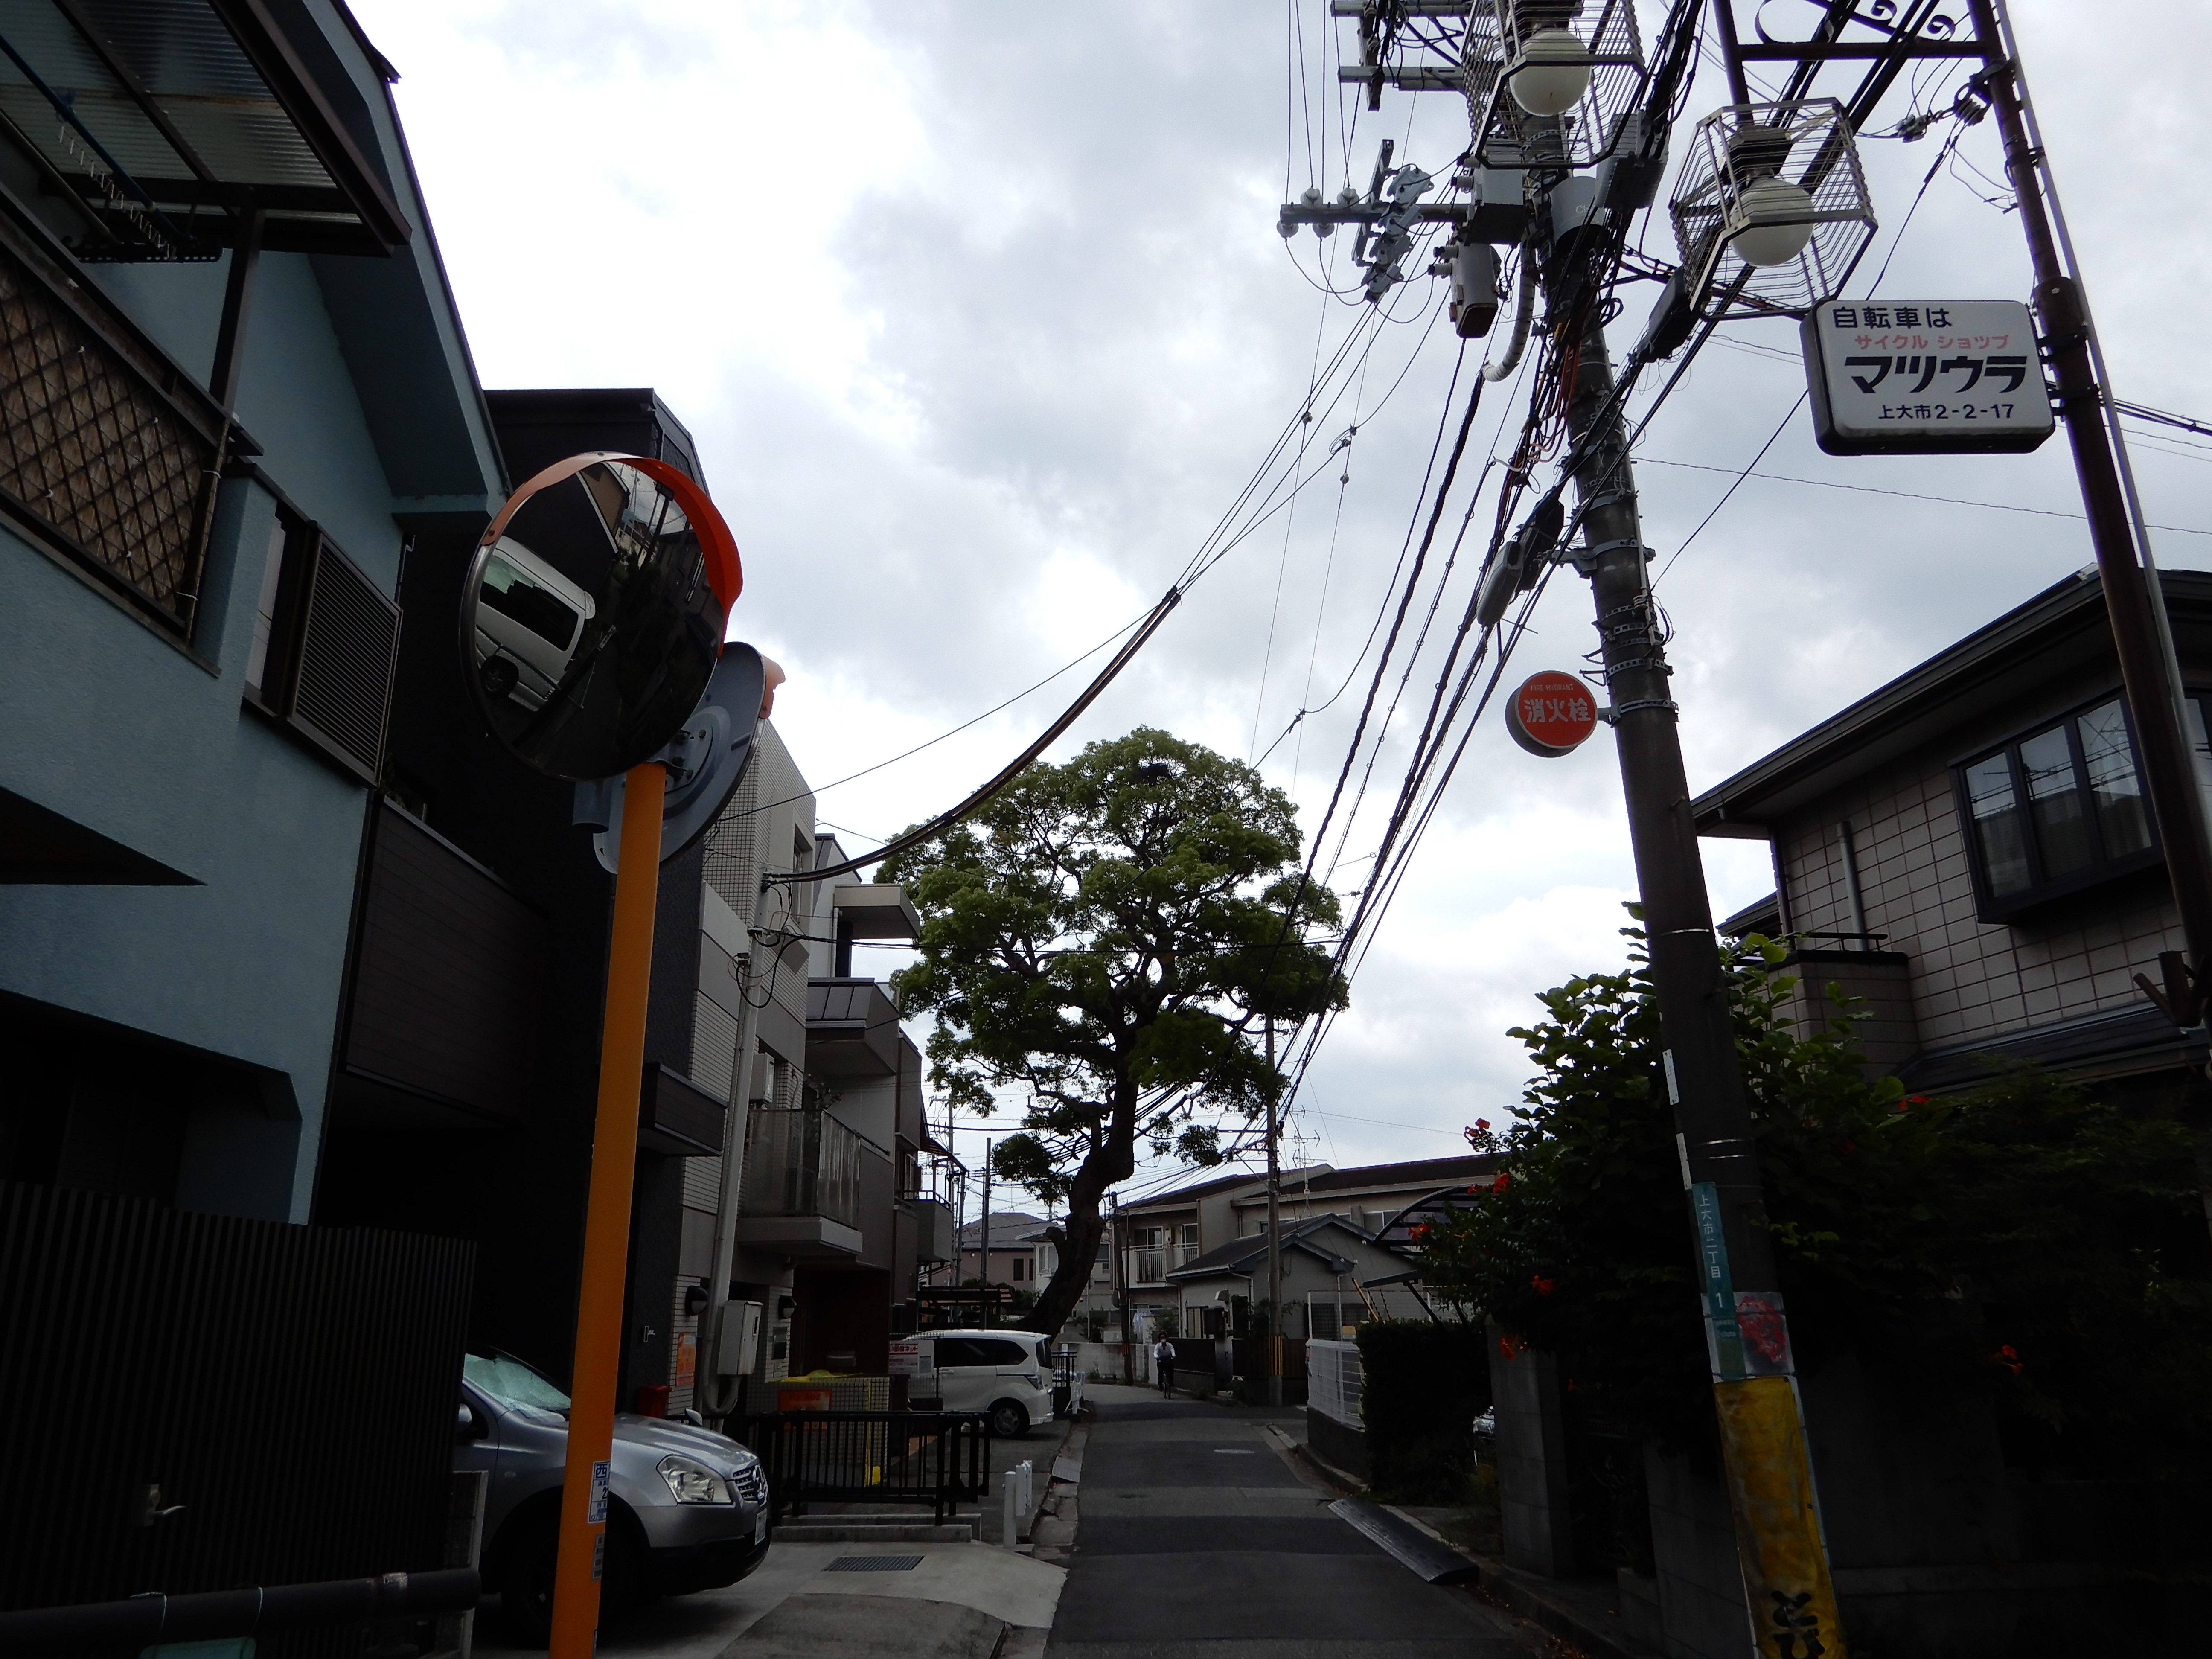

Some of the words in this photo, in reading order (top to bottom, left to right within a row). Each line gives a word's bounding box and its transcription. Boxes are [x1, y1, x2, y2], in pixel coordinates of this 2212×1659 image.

[1833, 306, 1953, 329] 自転車は
[1854, 335, 1928, 350] サイクル
[1844, 356, 2027, 393] マツウラ
[1878, 404, 2014, 420] 上大市2-2-17
[1524, 698, 1591, 723] 消火栓
[1700, 1194, 1721, 1278] 上大市二丁目
[1715, 1292, 1723, 1308] 1
